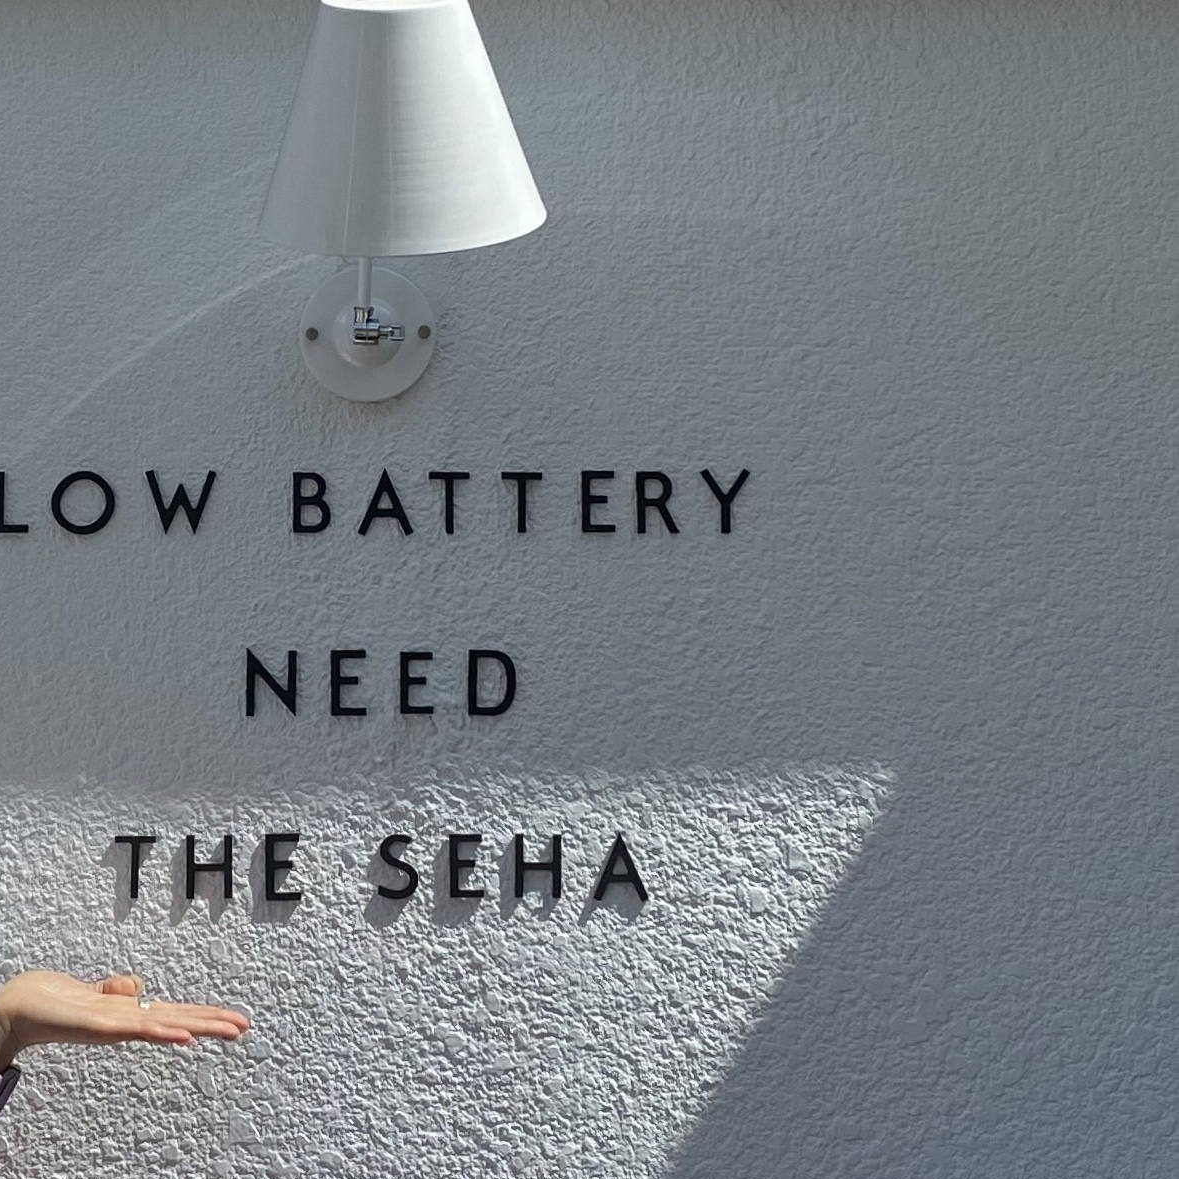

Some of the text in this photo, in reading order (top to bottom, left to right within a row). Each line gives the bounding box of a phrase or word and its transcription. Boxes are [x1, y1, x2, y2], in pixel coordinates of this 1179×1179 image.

[292, 467, 751, 537] BATTERY
[245, 647, 518, 719] NEED
[114, 831, 650, 903] THE SEHA
